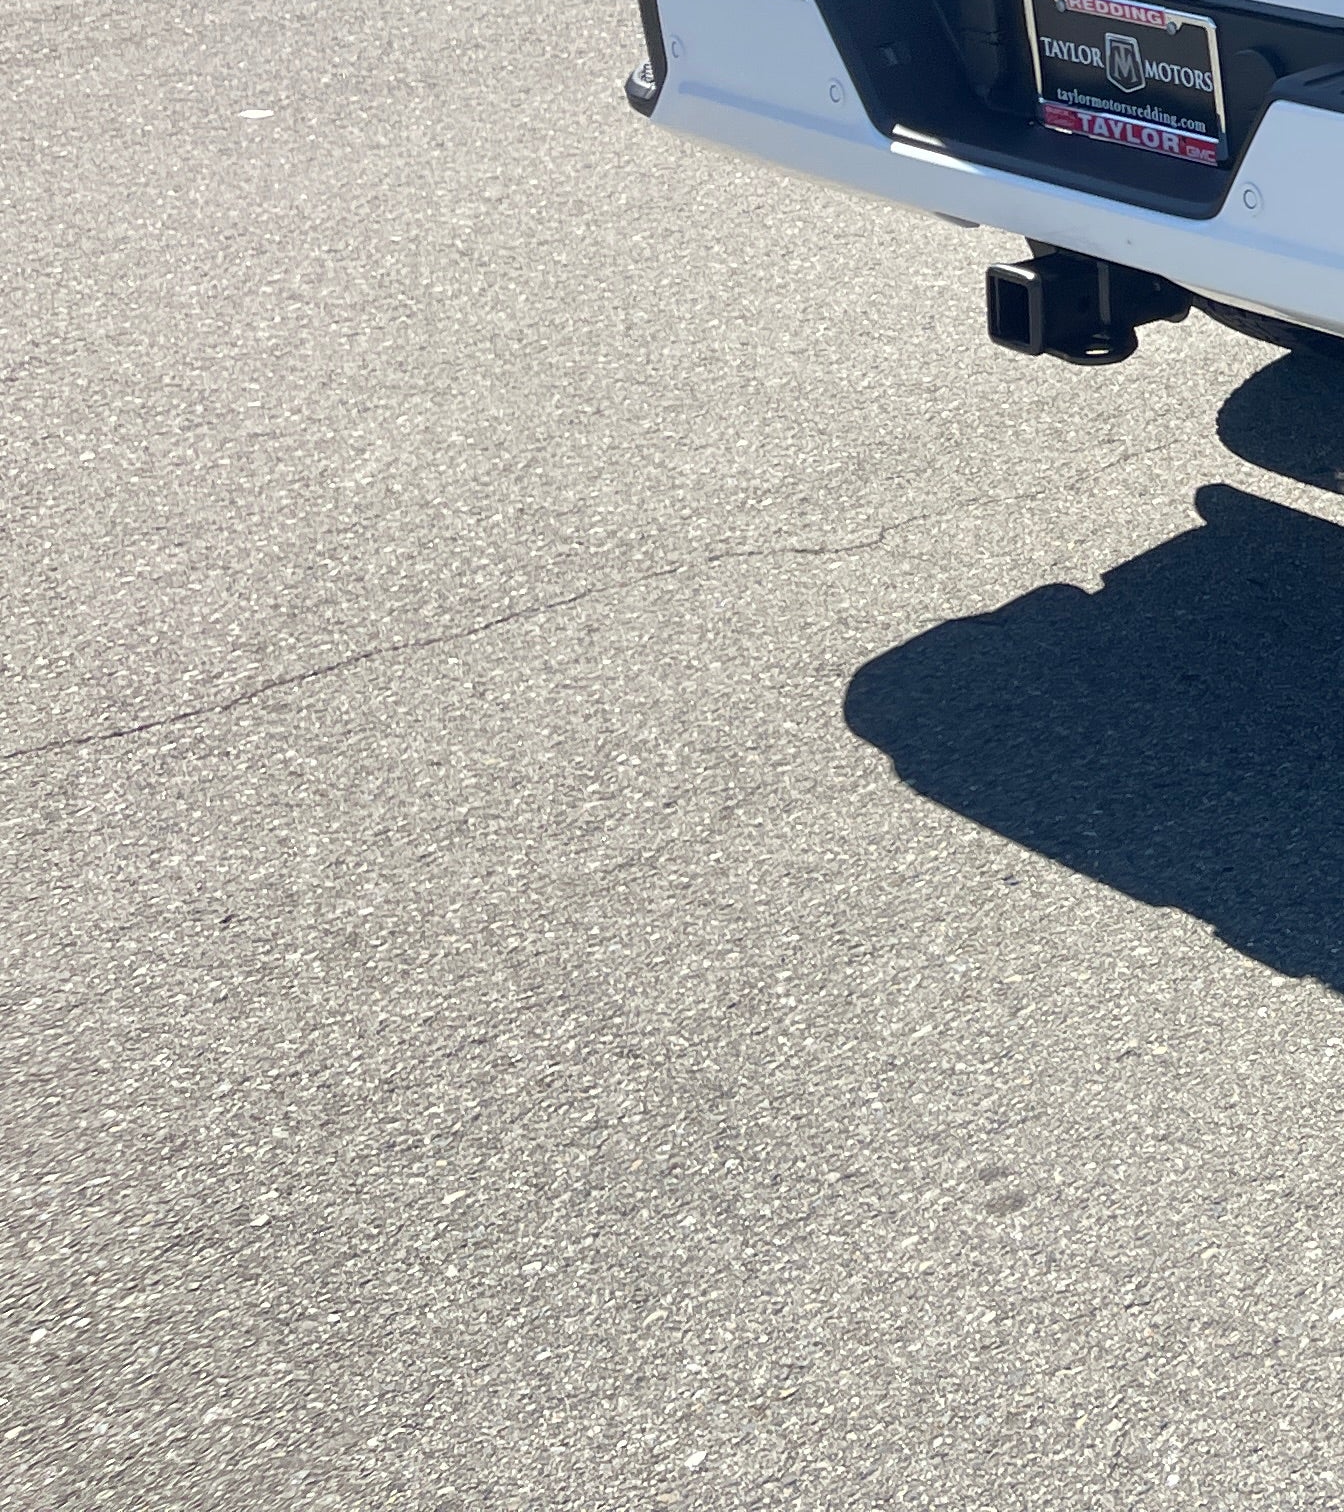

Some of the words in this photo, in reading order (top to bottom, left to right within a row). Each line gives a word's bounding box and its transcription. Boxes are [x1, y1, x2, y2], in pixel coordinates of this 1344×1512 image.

[1040, 36, 1105, 68] TAYLOR
[1144, 59, 1213, 92] MOTORS
[1057, 88, 1206, 133] taylormotorsredding.com
[1077, 113, 1180, 154] TAYLOR
[1185, 144, 1217, 162] GMC
